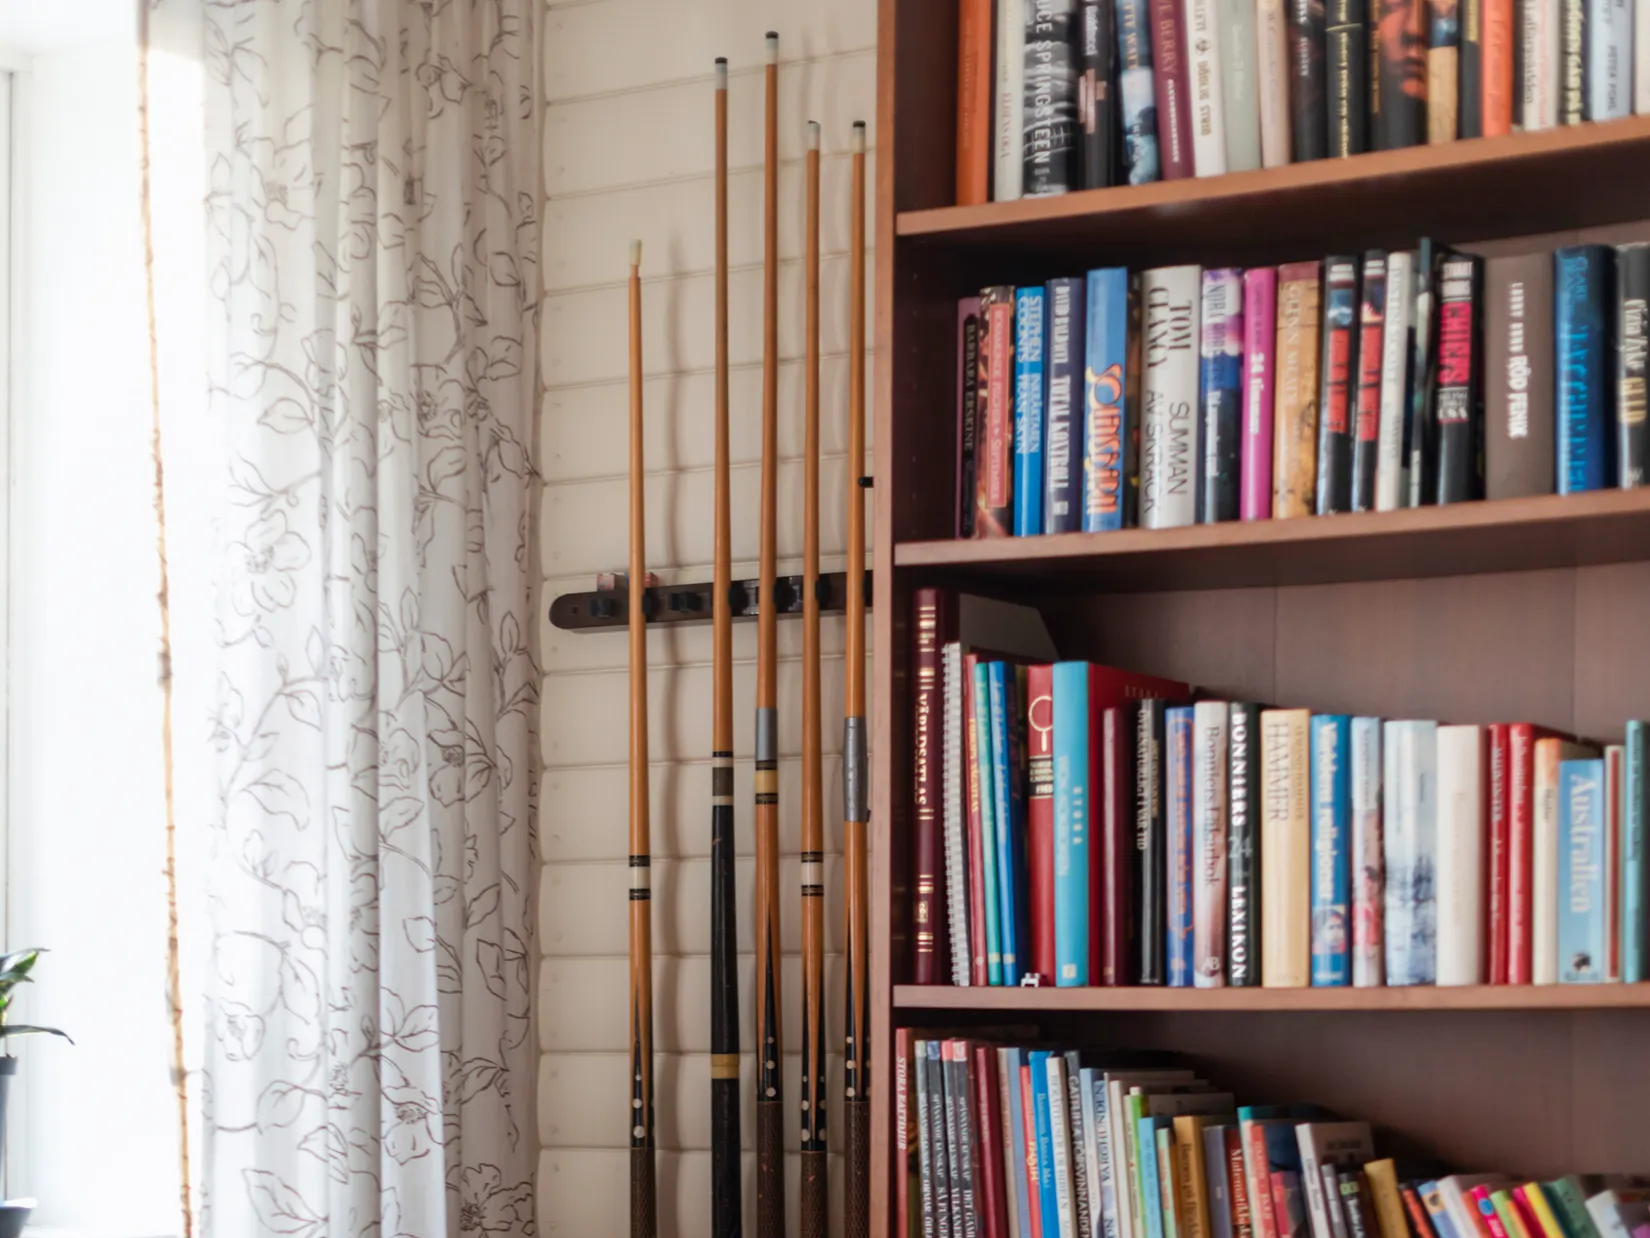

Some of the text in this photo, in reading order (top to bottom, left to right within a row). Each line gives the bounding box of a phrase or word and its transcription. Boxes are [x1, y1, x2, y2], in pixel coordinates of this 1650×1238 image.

[1034, 0, 1053, 163] UCE SPRINGSTEEN
[1146, 285, 1168, 370] CLANCY
[1168, 299, 1193, 352] TOM
[1250, 352, 1265, 374] 24
[962, 391, 976, 452] ERSKINE
[1507, 356, 1531, 439] RÖD FENIX
[1166, 402, 1190, 495] SUMMAN
[914, 694, 930, 806] VÄRLDSATLAS
[1204, 725, 1221, 803] Bonniers
[1231, 712, 1247, 827] BONNIERS
[1266, 722, 1290, 822] HAMMER
[1231, 885, 1247, 979] LEXIKON
[897, 1057, 906, 1094] STORA
[963, 1189, 973, 1210] DET
